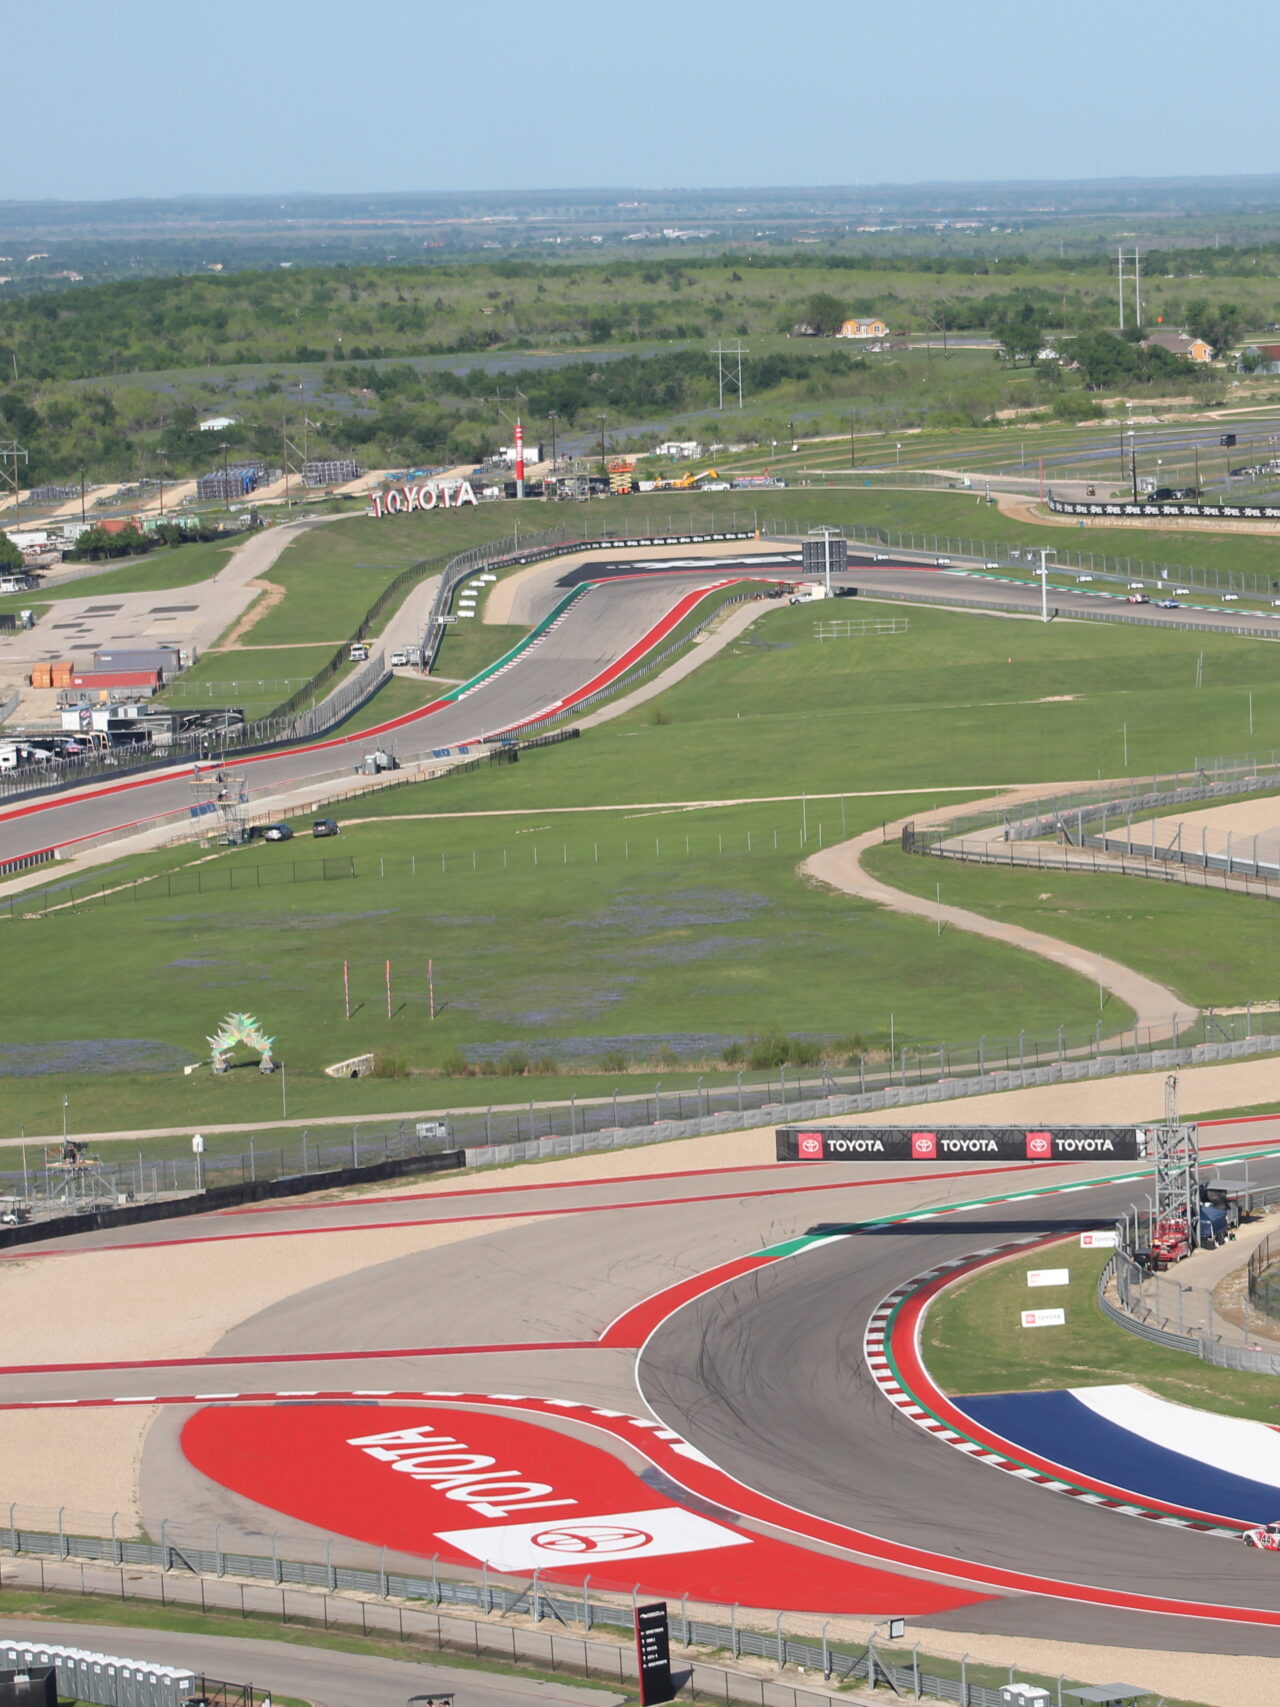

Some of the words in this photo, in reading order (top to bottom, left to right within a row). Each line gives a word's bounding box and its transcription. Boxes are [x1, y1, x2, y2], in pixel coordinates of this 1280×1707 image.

[369, 481, 478, 518] TOYOTA
[1124, 506, 1140, 514] XPEL
[1144, 506, 1159, 514] XPEL
[1162, 506, 1179, 514] XPEL
[1182, 506, 1199, 514] XPEL
[1202, 507, 1219, 515] XPEL
[1222, 507, 1240, 515] XPEL
[1243, 508, 1261, 516] XPEL
[1263, 508, 1280, 516] XPEL
[828, 1139, 884, 1152] TOYOTA
[941, 1139, 998, 1151] TOYOTA
[1056, 1138, 1114, 1151] TOYOTA
[345, 1425, 579, 1518] TOYOTA
